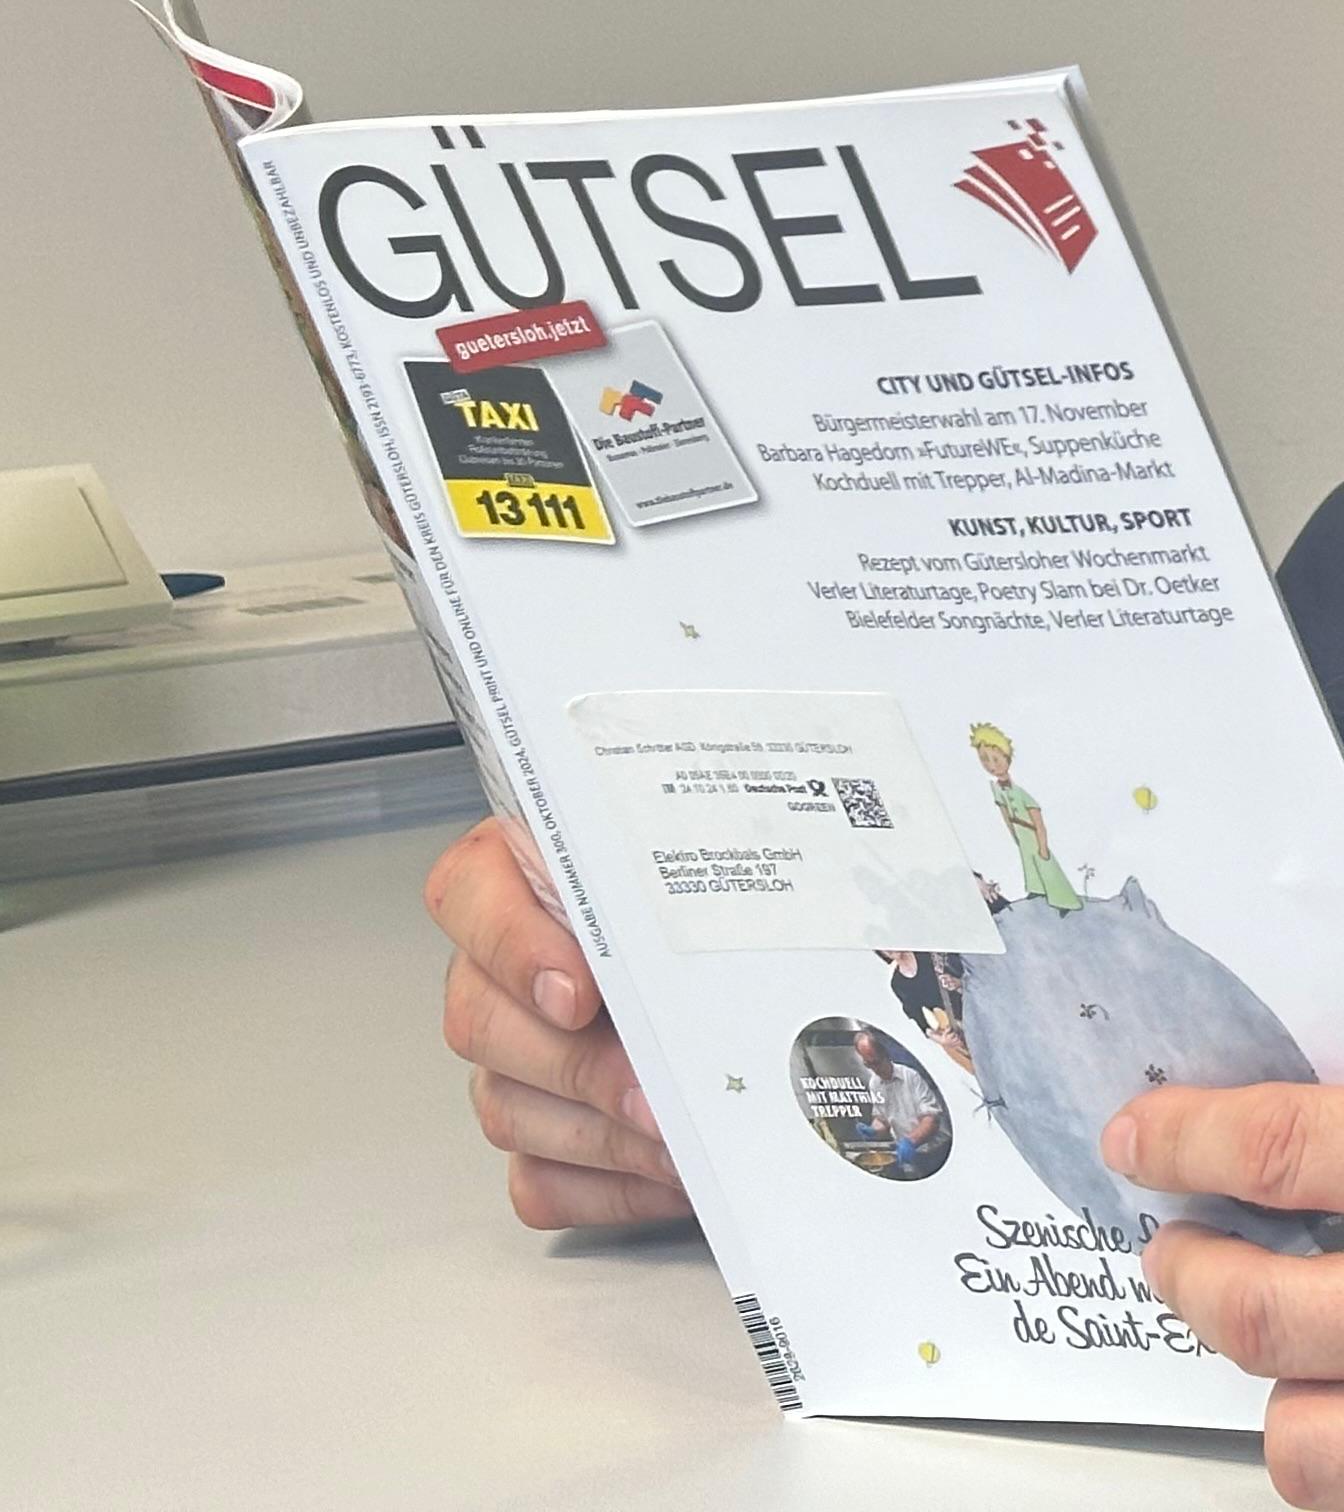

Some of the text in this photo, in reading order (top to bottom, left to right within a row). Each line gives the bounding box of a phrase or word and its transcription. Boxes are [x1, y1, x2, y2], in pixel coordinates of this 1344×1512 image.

[318, 125, 983, 319] GÜTSEL
[302, 249, 321, 279] UND
[315, 279, 352, 350] KOSTENLOS
[456, 315, 590, 359] guetersloh.jetzt
[877, 362, 1135, 395] CITY UND GÜTSEL-INFOS
[371, 410, 390, 438] ISSN
[454, 400, 539, 431] TAXI
[813, 399, 1148, 437] Bürgermeisterwahl am 17. November
[758, 442, 823, 463] Barbara
[826, 441, 915, 466] Hagedorn
[1028, 428, 1162, 458] Suppenküche
[814, 460, 1175, 493] Kochduell mit Trepper, Al-Madina-Markt
[476, 490, 585, 529] 13 111
[949, 508, 1192, 539] KUNST, KULTUR, SPORT
[415, 512, 435, 545] KREIS
[429, 546, 446, 571] DEN
[859, 544, 1210, 576] Rezept vom Gütersloher Wochenmarkt
[440, 570, 457, 596] FÜR
[808, 574, 1220, 605] Verler Literaturtage, Poetry Slam bei Dr. Oetker
[450, 596, 476, 641] ONLINE
[848, 605, 1235, 635] Bielefelder Songnächte, Verler Literaturtage
[470, 641, 487, 668] UND
[481, 667, 502, 702] PRINT
[496, 704, 521, 747] GÜTSEL
[528, 777, 556, 831] OKTOBER
[652, 849, 698, 864] Elektro
[762, 848, 804, 862] GmbH
[658, 865, 709, 880] Berliner
[711, 862, 753, 877] Straße
[560, 854, 588, 905] NUMMER
[708, 875, 795, 893] GÜTERSLOH
[583, 906, 611, 959] AUSGABE
[828, 1090, 886, 1104] MATTHIAS
[976, 1204, 1132, 1255] Szenische
[954, 1252, 1021, 1293] Ein
[1022, 1253, 1127, 1300] Abend
[1013, 1299, 1218, 1357] de Saint-Ex
